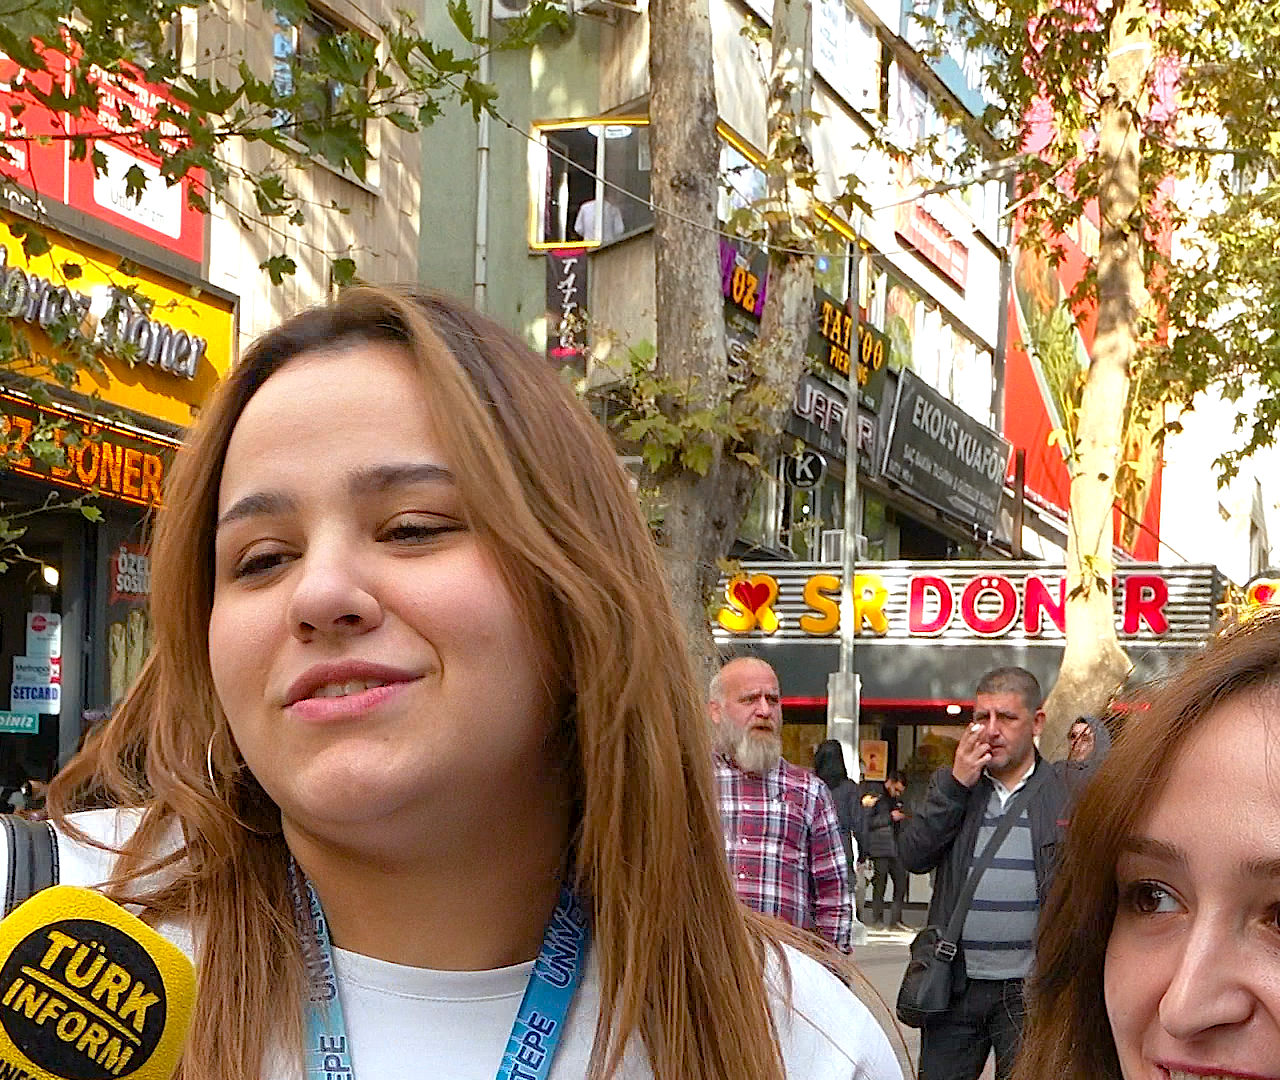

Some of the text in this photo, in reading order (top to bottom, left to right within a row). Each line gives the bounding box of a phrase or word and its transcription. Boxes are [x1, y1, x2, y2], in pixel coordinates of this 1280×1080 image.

[820, 300, 883, 371] TATOO
[912, 394, 958, 452] EKOL'S
[956, 429, 1006, 487] KUAFÖR
[908, 573, 1170, 638] DÖNR
[13, 686, 59, 700] SETCARD
[39, 930, 161, 1034] TÜRK
[2, 977, 136, 1075] INFORM
